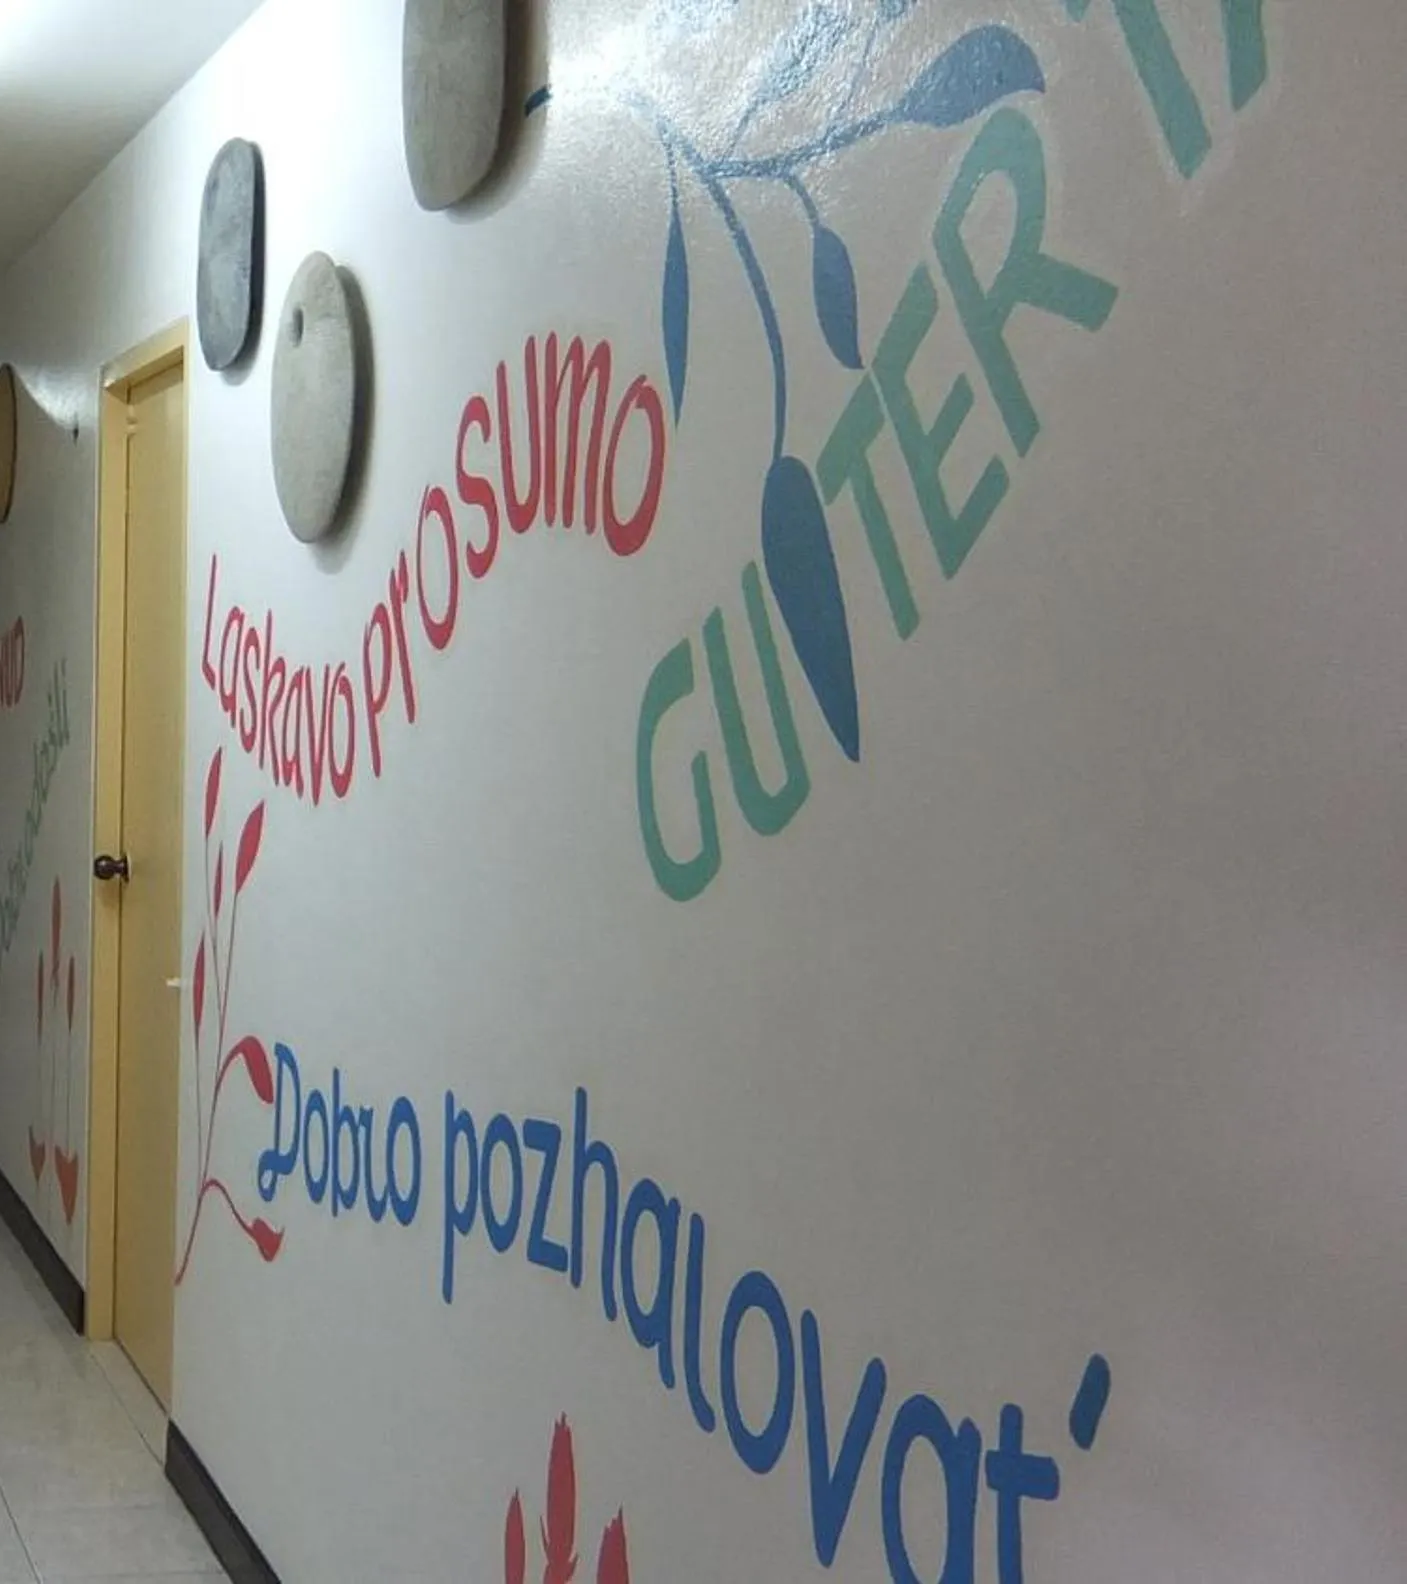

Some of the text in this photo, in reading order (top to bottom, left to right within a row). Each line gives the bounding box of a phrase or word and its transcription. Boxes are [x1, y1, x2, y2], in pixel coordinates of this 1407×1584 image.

[201, 331, 666, 808] Laskavo prosumo
[636, 108, 1119, 903] GUTER
